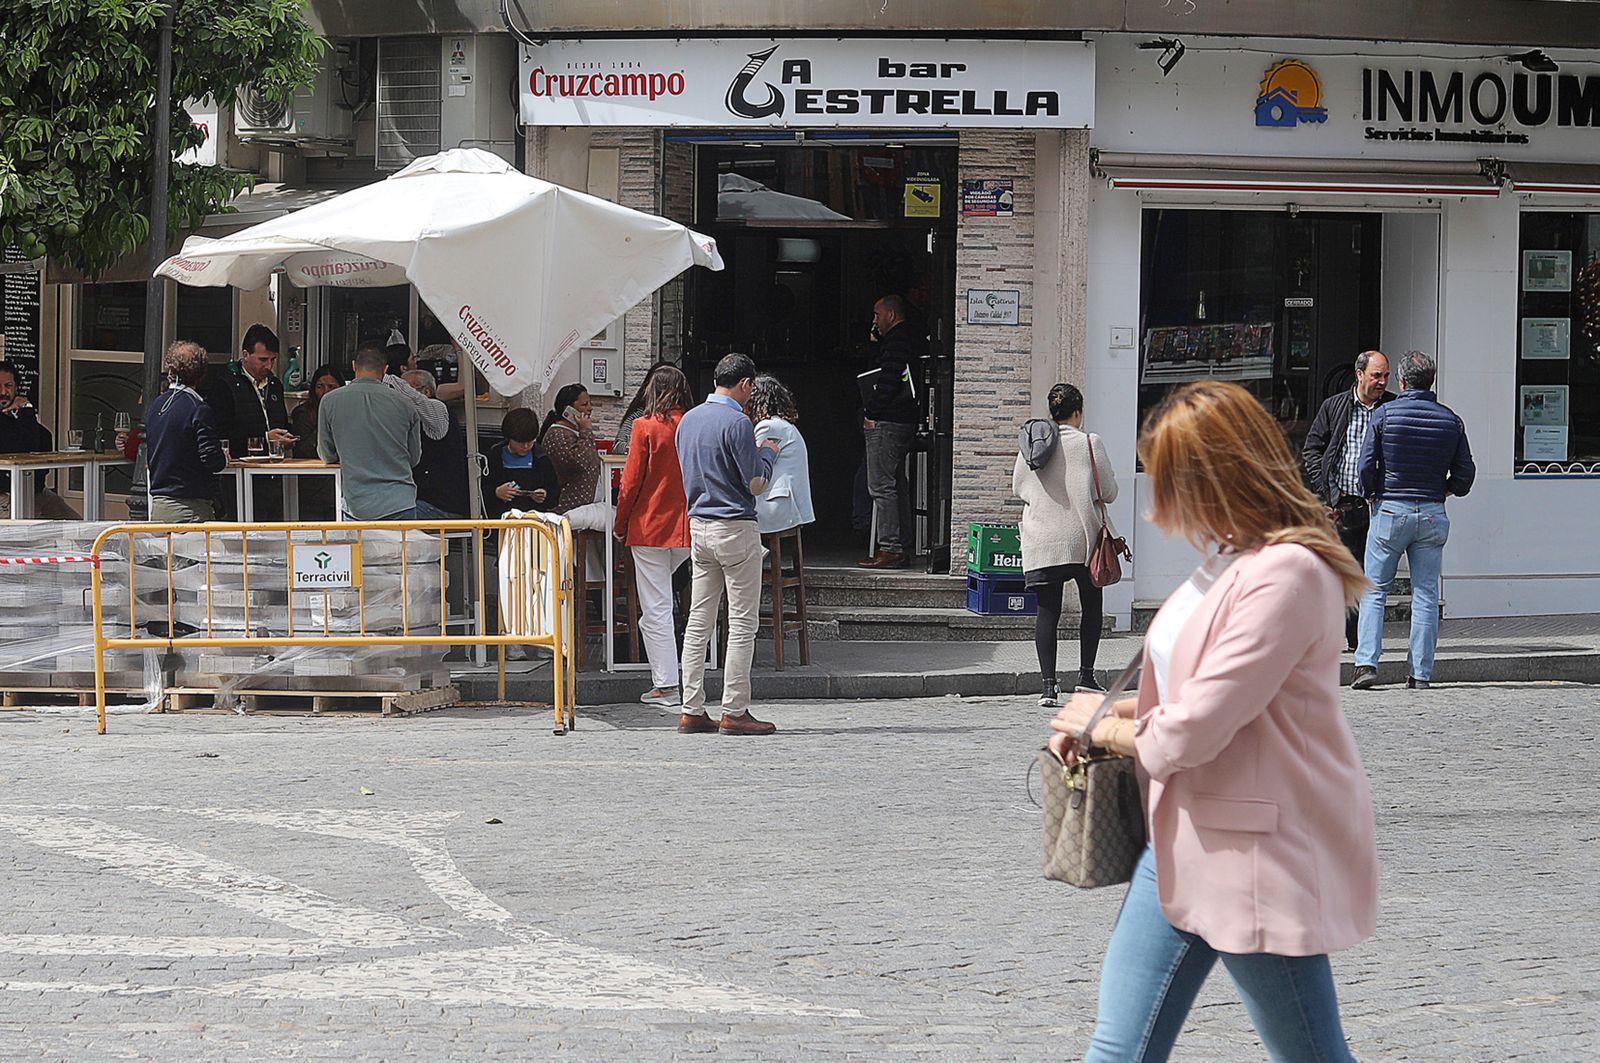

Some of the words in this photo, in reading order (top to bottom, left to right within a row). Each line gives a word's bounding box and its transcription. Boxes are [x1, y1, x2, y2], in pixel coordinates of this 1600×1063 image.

[878, 58, 966, 78] bar
[529, 65, 686, 101] Cruzcampo
[794, 88, 1060, 117] ESTRELLA
[1364, 127, 1433, 141] Servicios
[457, 332, 490, 374] ESPECIAL
[458, 304, 517, 377] Cruzcampo
[295, 570, 350, 582] Terracivil
